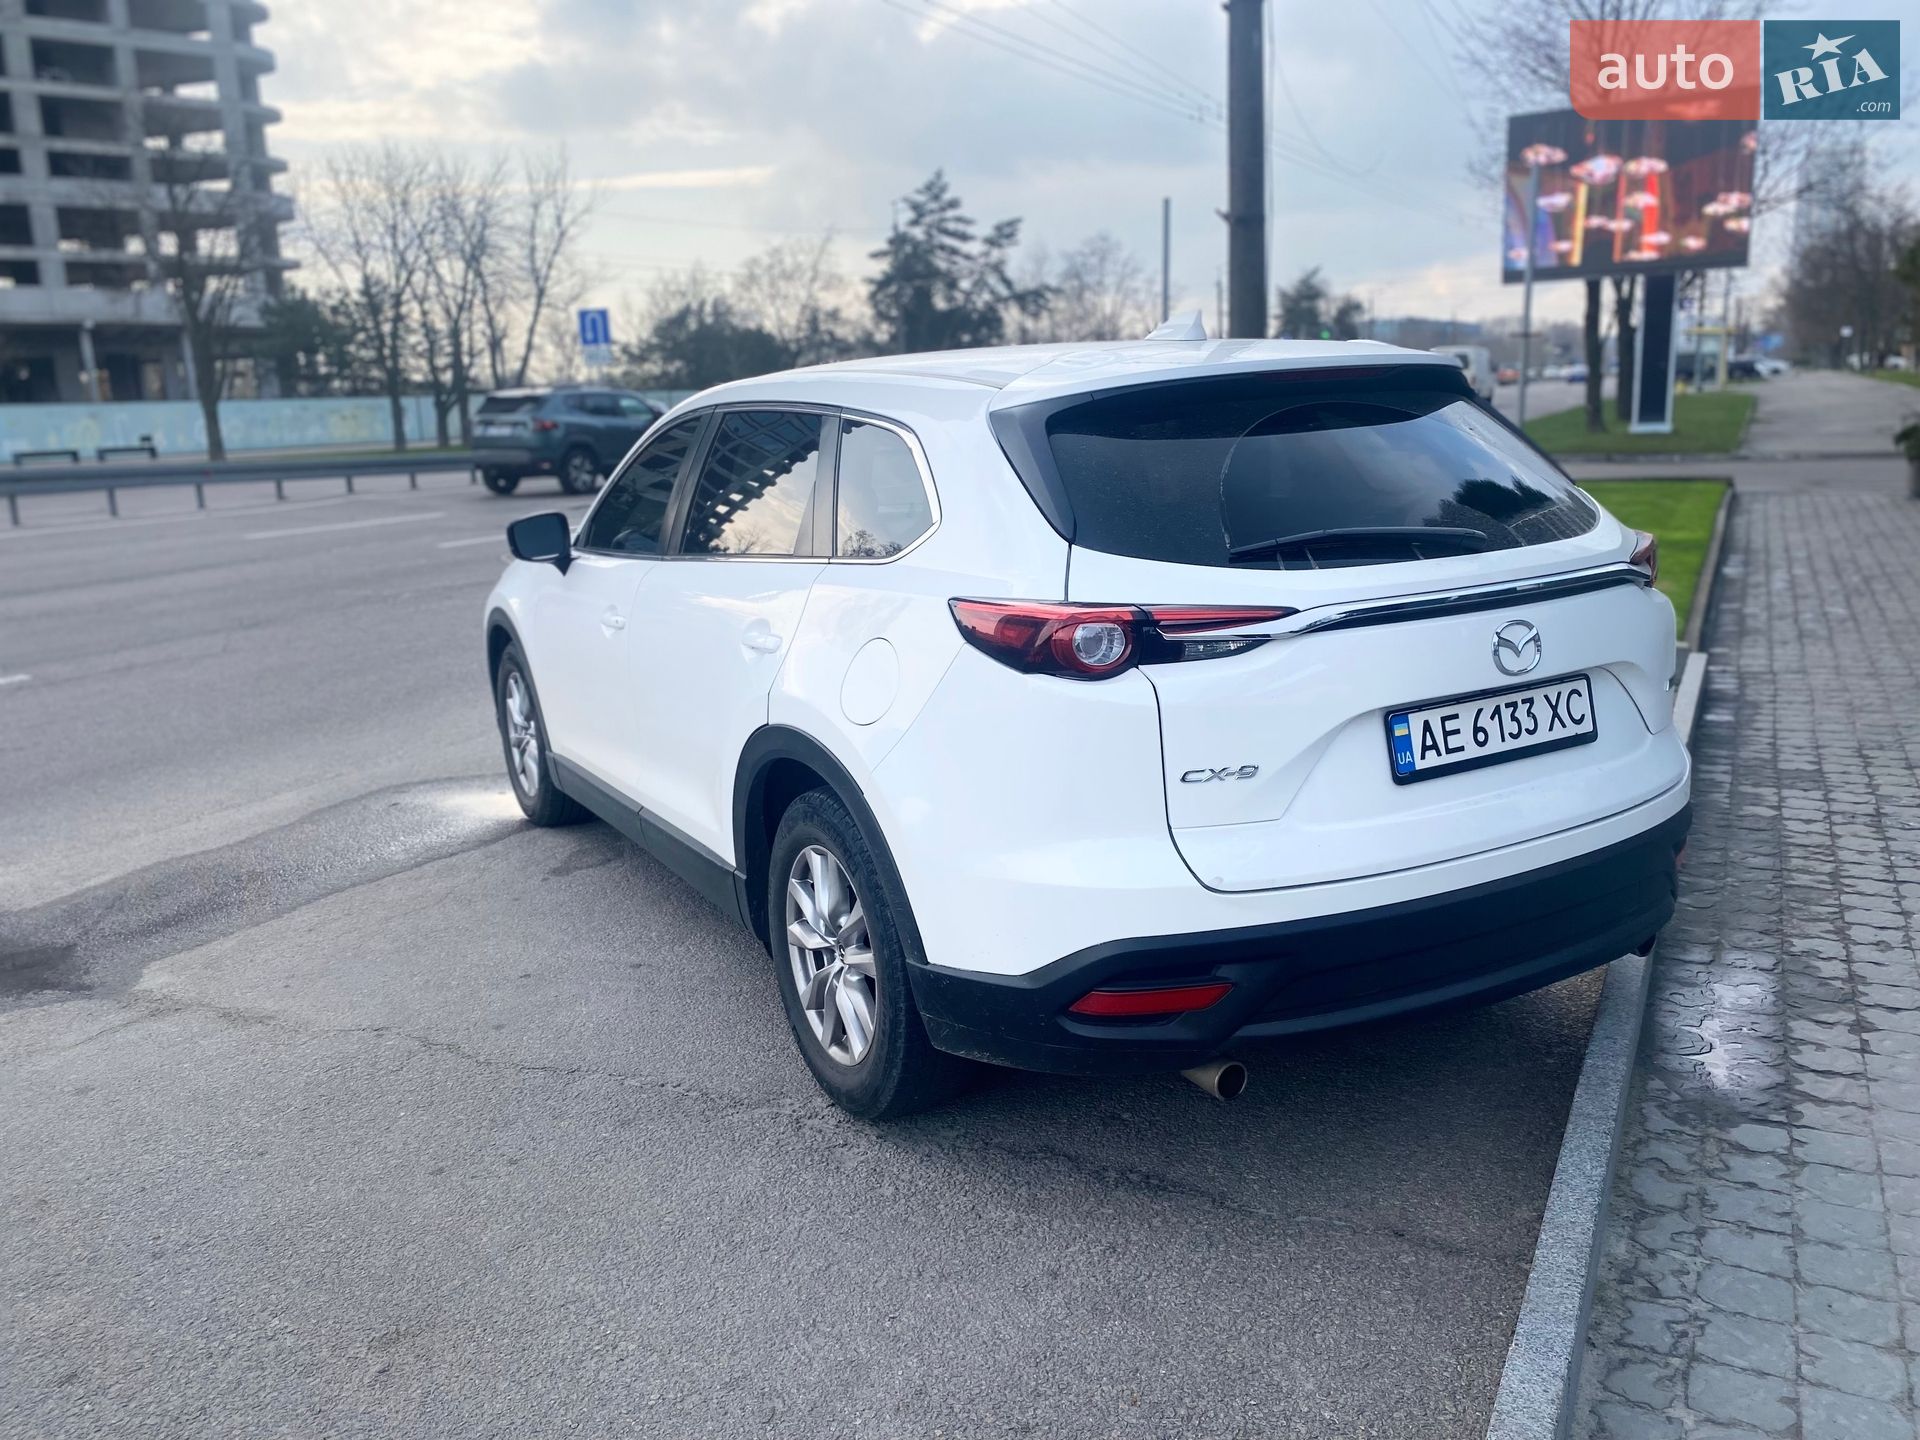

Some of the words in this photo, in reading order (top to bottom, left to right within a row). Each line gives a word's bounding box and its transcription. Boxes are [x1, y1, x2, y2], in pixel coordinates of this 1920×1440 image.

[1420, 713, 1465, 761] AE
[1472, 697, 1539, 748] 6133
[1543, 688, 1586, 733] XC
[1398, 752, 1414, 765] UA
[1180, 765, 1259, 783] CX-9
